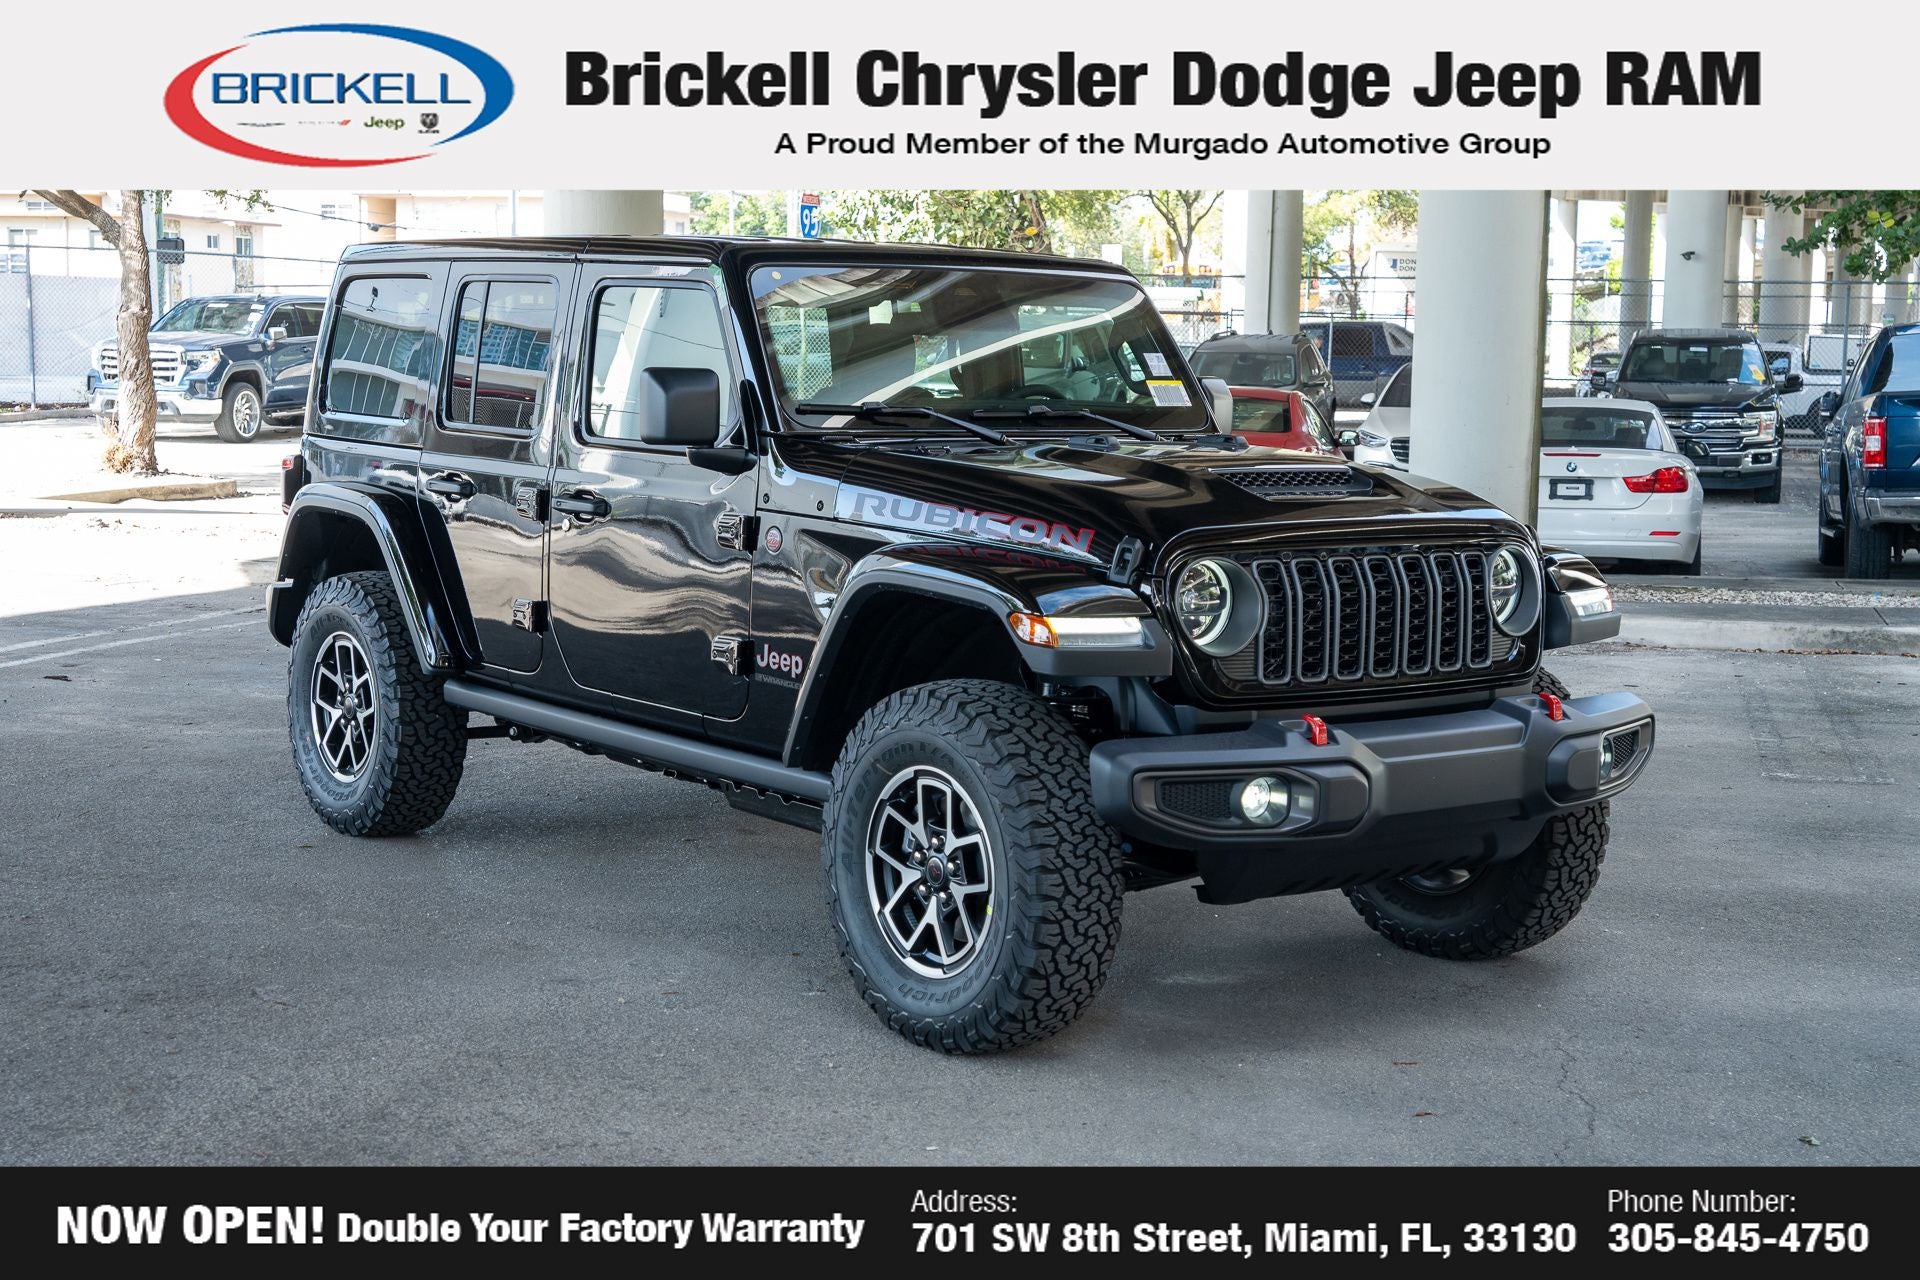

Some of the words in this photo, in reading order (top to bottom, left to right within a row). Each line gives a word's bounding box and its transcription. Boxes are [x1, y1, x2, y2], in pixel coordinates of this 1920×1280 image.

[802, 208, 819, 236] 95
[850, 492, 1097, 553] RUBICON
[756, 643, 804, 679] Jeep
